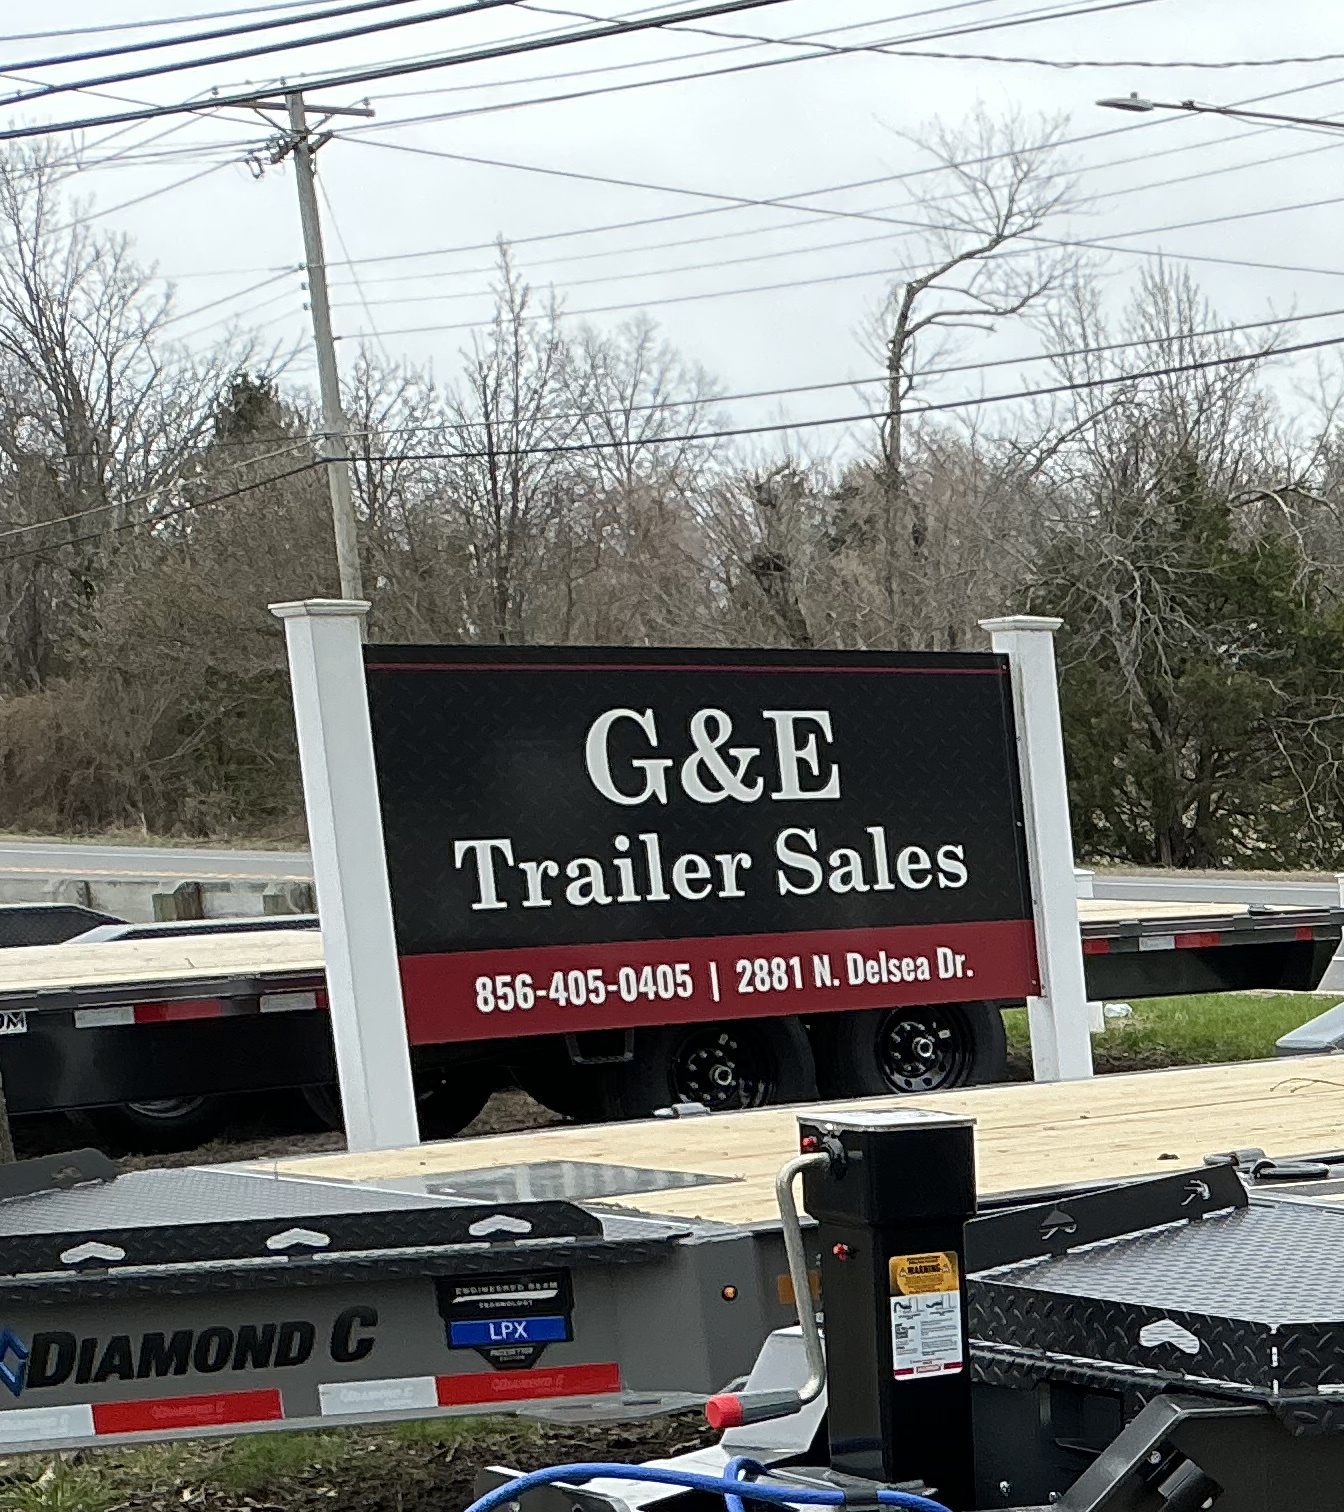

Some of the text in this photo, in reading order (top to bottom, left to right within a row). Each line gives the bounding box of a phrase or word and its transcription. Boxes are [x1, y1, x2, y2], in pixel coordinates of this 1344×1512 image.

[584, 707, 841, 806] G&E
[453, 825, 969, 911] Trailer Sales
[474, 962, 694, 1014] 856-405-0405
[736, 956, 804, 995] 2881
[812, 953, 841, 989] N.
[846, 950, 931, 987] Delsea
[937, 946, 975, 979] Dr.
[26, 1305, 378, 1389] DIAMOND C
[489, 1320, 529, 1341] LPX
